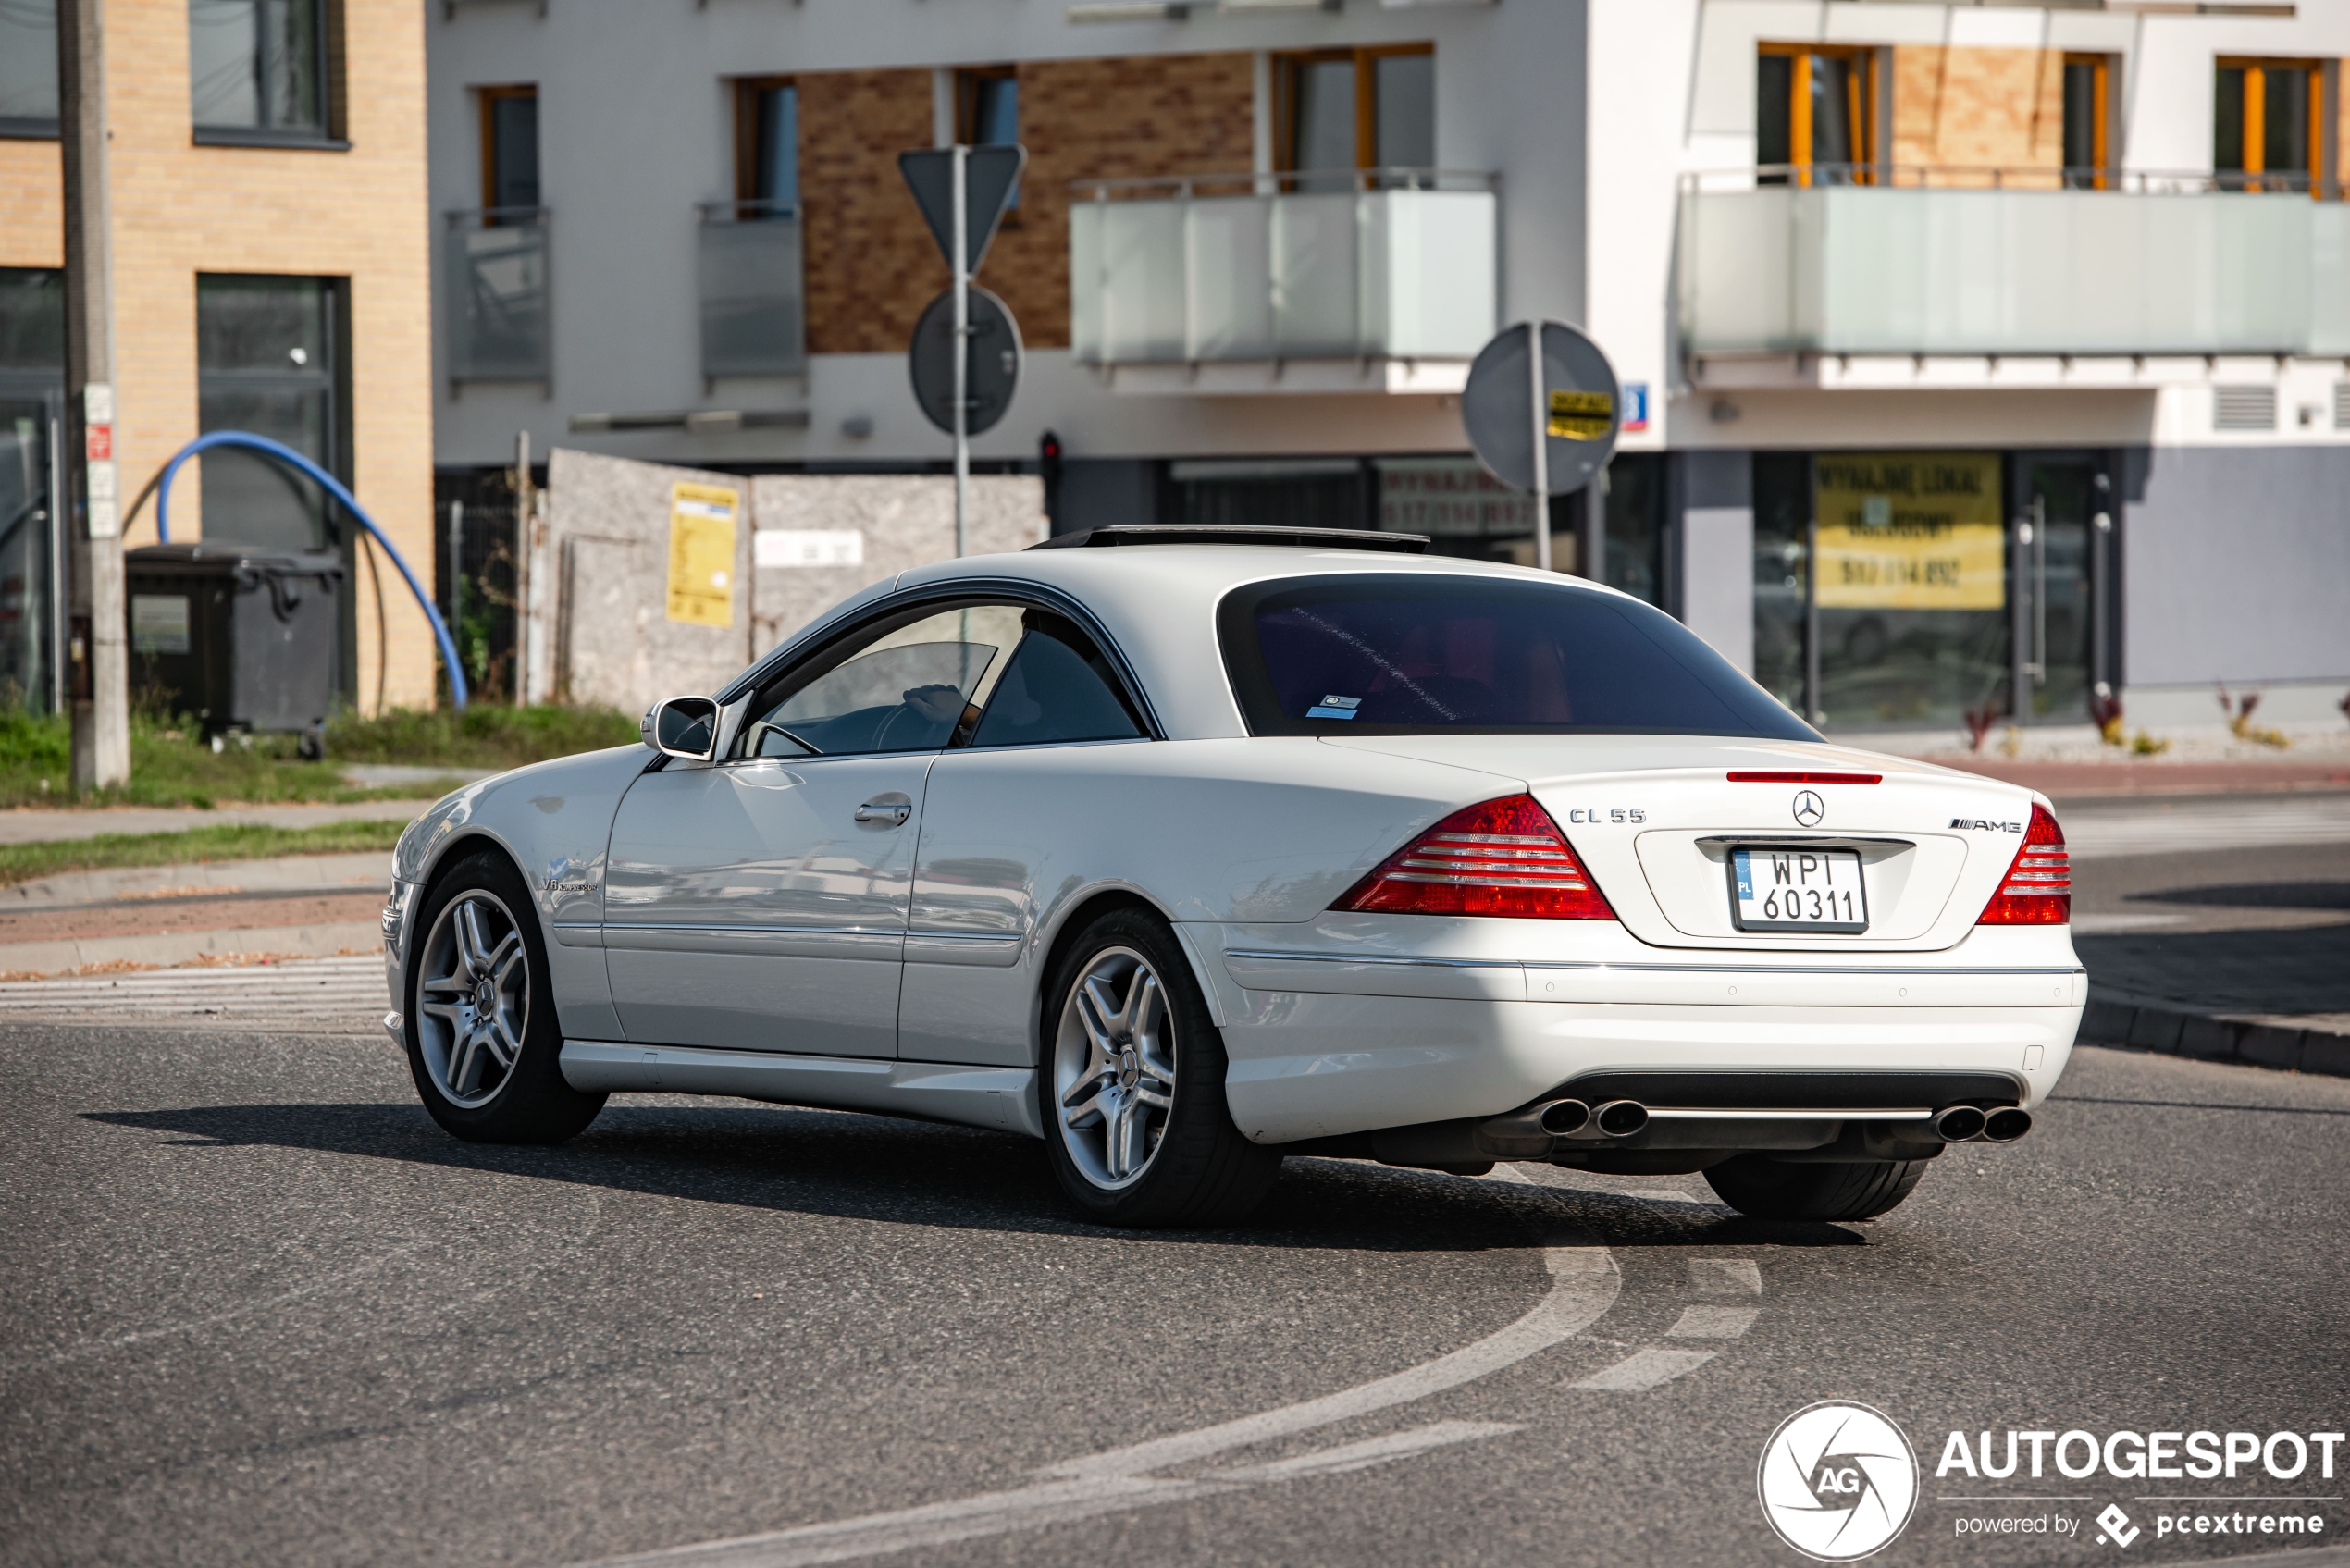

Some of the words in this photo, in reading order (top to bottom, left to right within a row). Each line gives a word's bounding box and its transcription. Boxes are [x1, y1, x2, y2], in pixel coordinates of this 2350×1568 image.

[1841, 558, 1879, 587] 517
[1925, 559, 1960, 590] 892
[1570, 809, 1602, 823] CL
[1611, 809, 1646, 823] 55
[1972, 820, 2022, 833] AMG
[1772, 854, 1832, 885] WPI
[1738, 881, 1751, 893] PL
[1763, 889, 1853, 920] 60311
